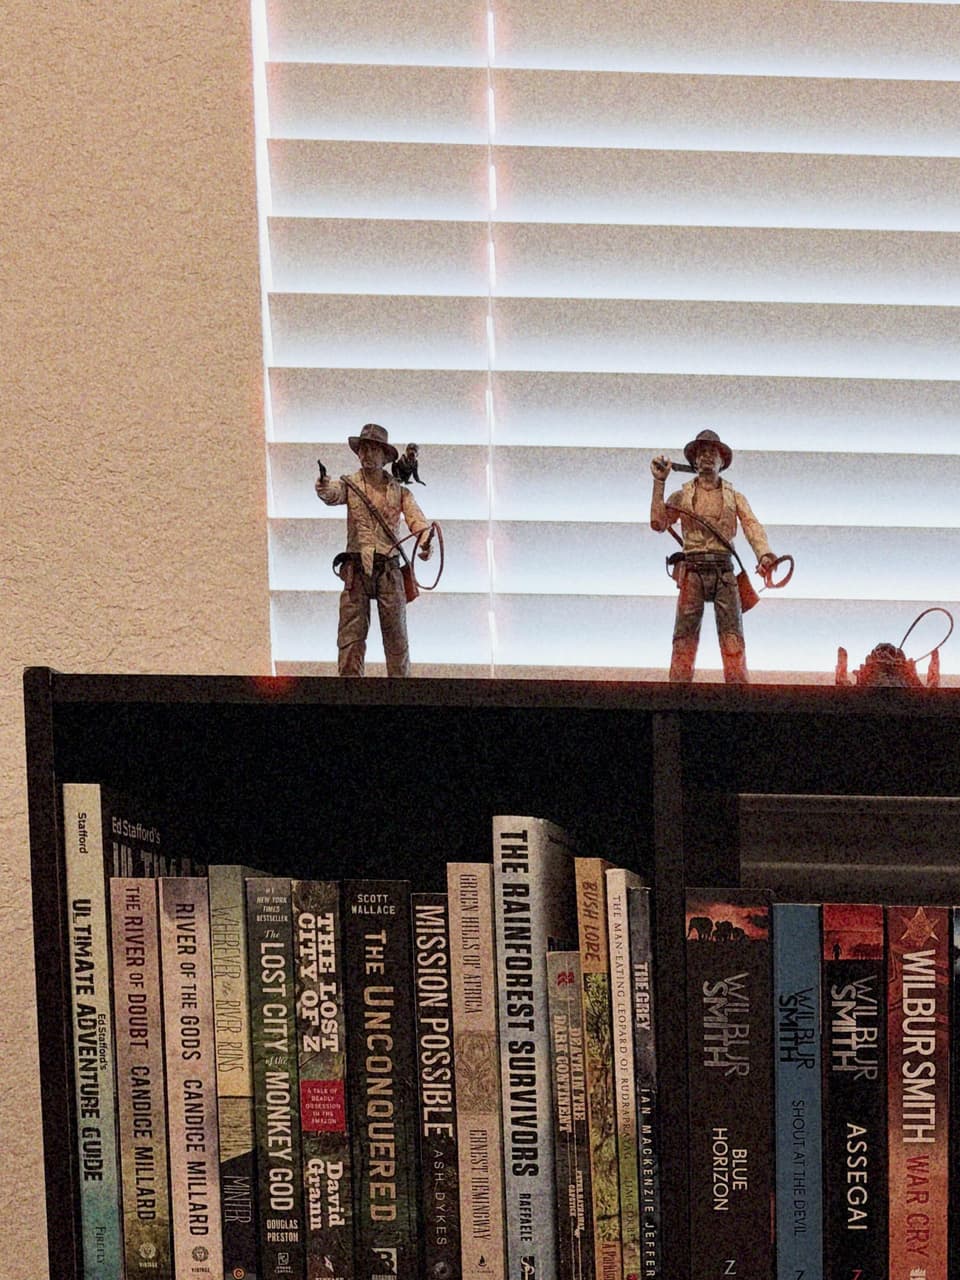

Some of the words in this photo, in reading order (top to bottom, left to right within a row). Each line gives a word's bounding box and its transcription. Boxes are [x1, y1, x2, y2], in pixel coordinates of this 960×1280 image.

[78, 812, 88, 854] Stafford
[112, 816, 122, 833] Ed
[123, 817, 160, 844] Stafford's
[501, 830, 529, 873] THE
[351, 906, 395, 914] WALLACE
[357, 894, 388, 903] SCOTT
[73, 899, 95, 995] ULTIMATE
[317, 913, 335, 973] THE
[364, 930, 386, 975] THE
[415, 906, 448, 1007] MISSION
[502, 884, 534, 1031] RAINFOREST
[320, 982, 338, 1052] LOST
[703, 981, 728, 1067] SMITH
[724, 972, 749, 1076] WILBUR
[831, 984, 856, 1071] SMITH
[853, 975, 878, 1080] WILBUR
[901, 950, 936, 1055] WILBUR
[76, 1003, 100, 1118] ADVENTURE
[419, 1018, 454, 1138] POSSIBLE
[131, 1066, 152, 1138] CANDICE
[184, 1080, 204, 1152] CANDICE
[363, 986, 397, 1222] UNCONQUERED
[508, 1041, 539, 1177] SURVIVORS
[901, 1060, 936, 1143] SMITH
[82, 1127, 103, 1181] GUIDE
[135, 1147, 155, 1220] MILLARD
[713, 1128, 729, 1211] HORIZON
[732, 1149, 747, 1191] BLUE
[847, 1123, 867, 1230] ASSEGAI
[906, 1156, 929, 1204] WAR
[187, 1162, 209, 1236] MILLARD
[266, 1219, 298, 1229] DOUGLAS
[307, 1158, 324, 1230] Grann
[326, 1161, 344, 1227] David
[906, 1214, 929, 1257] CRY
